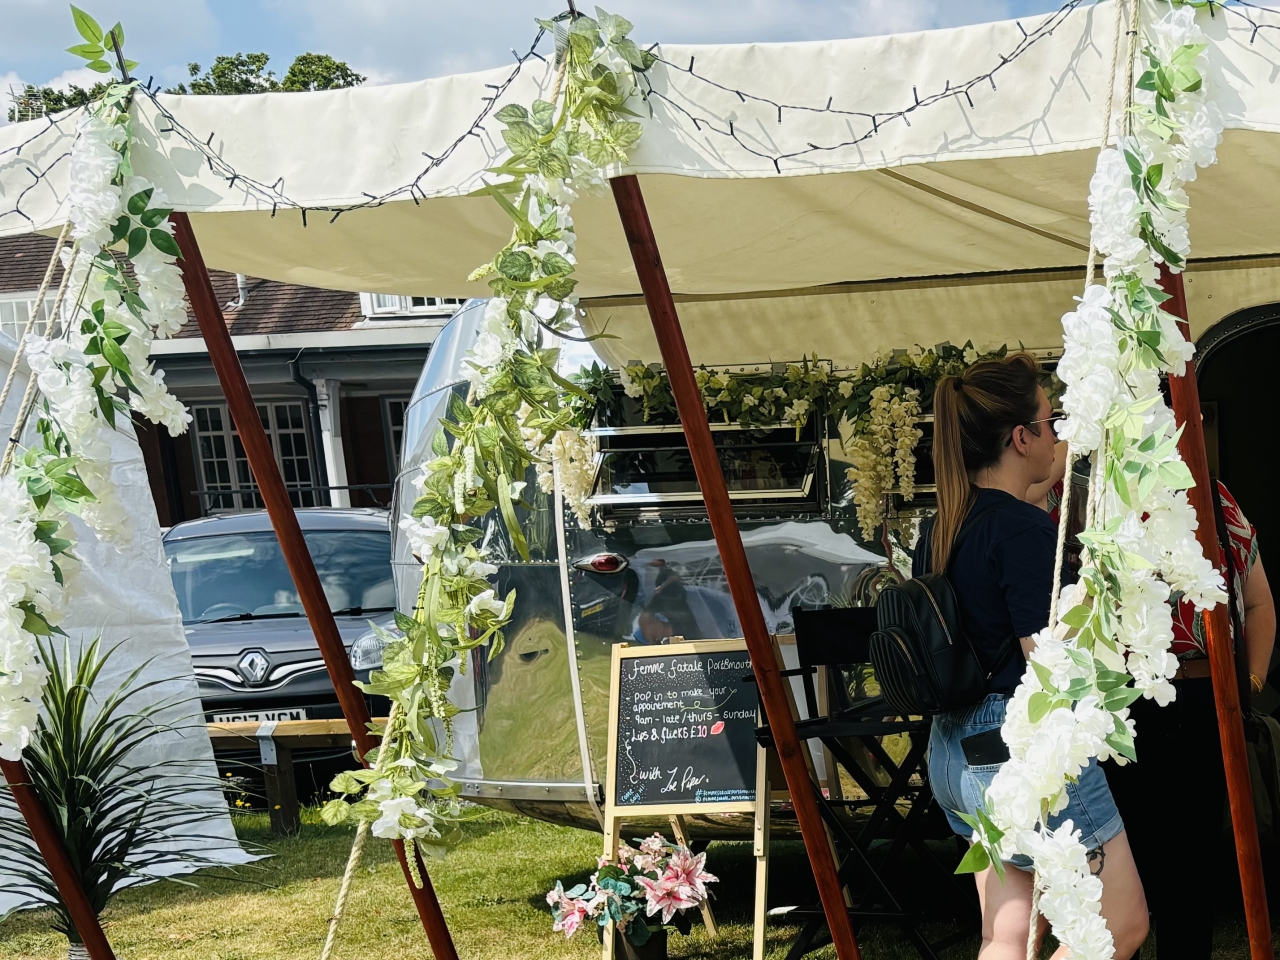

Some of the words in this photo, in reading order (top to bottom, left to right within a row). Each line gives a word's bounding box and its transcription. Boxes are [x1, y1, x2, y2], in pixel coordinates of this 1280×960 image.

[653, 692, 663, 700] in
[667, 690, 678, 699] to
[681, 688, 703, 698] make
[708, 686, 727, 700] your
[632, 700, 685, 713] appointment
[634, 714, 653, 725] 9am
[723, 709, 757, 723] sunday
[650, 728, 660, 741] &
[690, 725, 708, 739] £10
[639, 766, 662, 780] with
